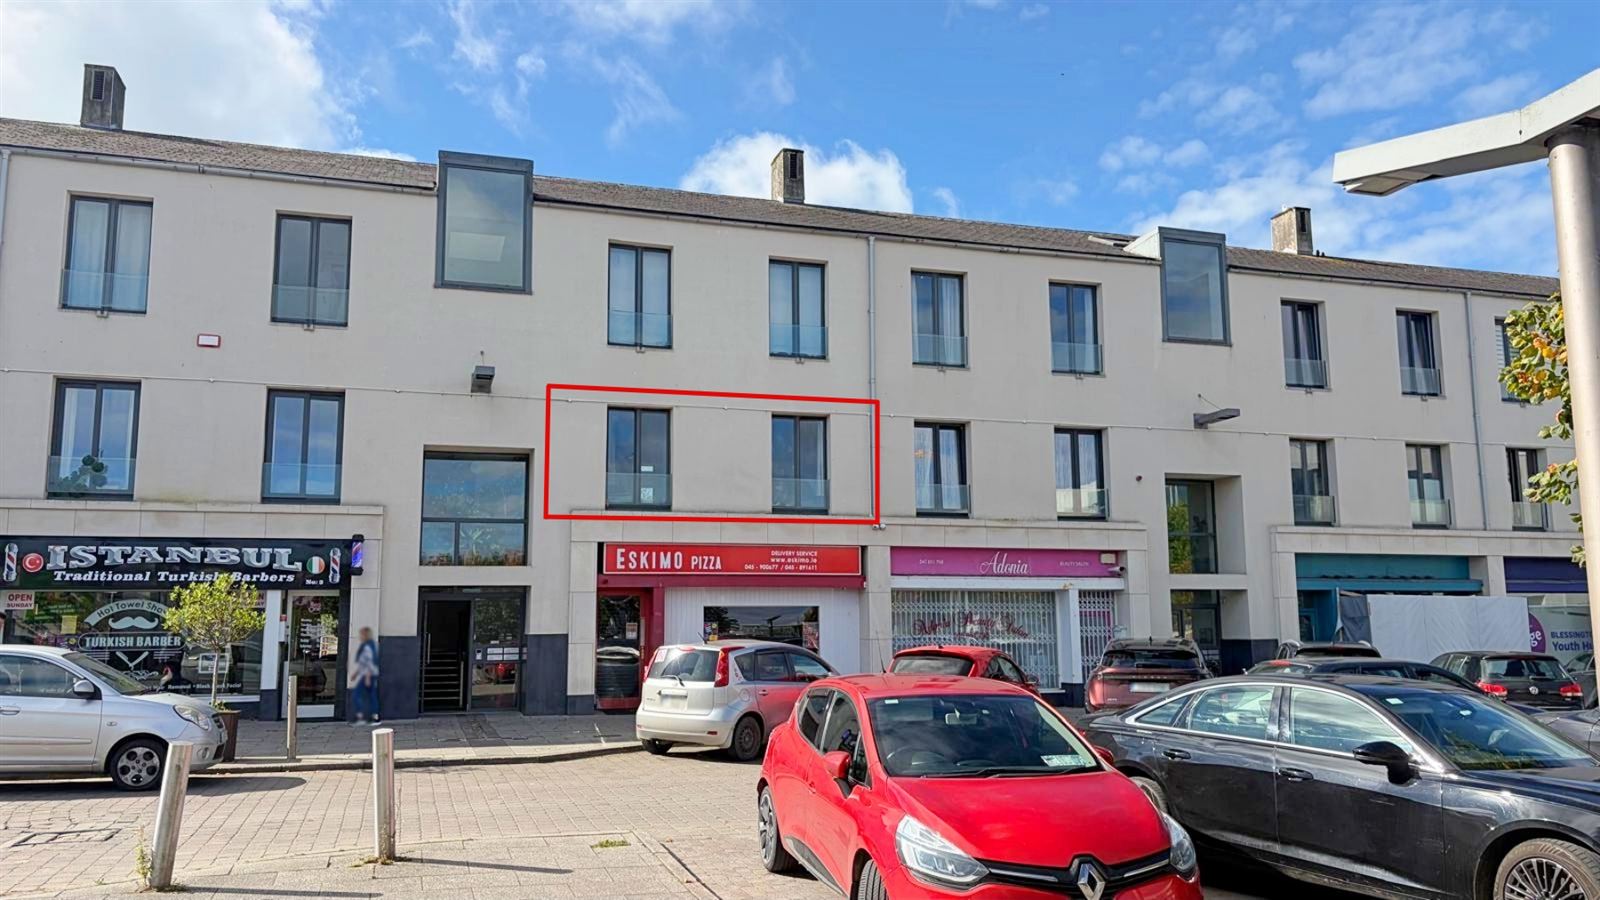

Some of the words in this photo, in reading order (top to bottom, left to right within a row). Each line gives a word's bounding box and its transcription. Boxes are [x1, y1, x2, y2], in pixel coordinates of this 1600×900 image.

[46, 545, 302, 570] ISTANBUL
[616, 548, 683, 570] ESKIMO
[690, 555, 722, 570] PIZZA
[980, 551, 1028, 574] Adonia
[53, 570, 151, 582] Traditional
[231, 571, 295, 583] Barbers
[7, 593, 33, 602] OPEN
[115, 601, 145, 610] Towel
[145, 602, 167, 614] Sha
[1550, 631, 1592, 639] BLESSINGT
[85, 636, 134, 648] TURKISH
[136, 636, 181, 648] BARBER
[1552, 640, 1581, 651] Youth
